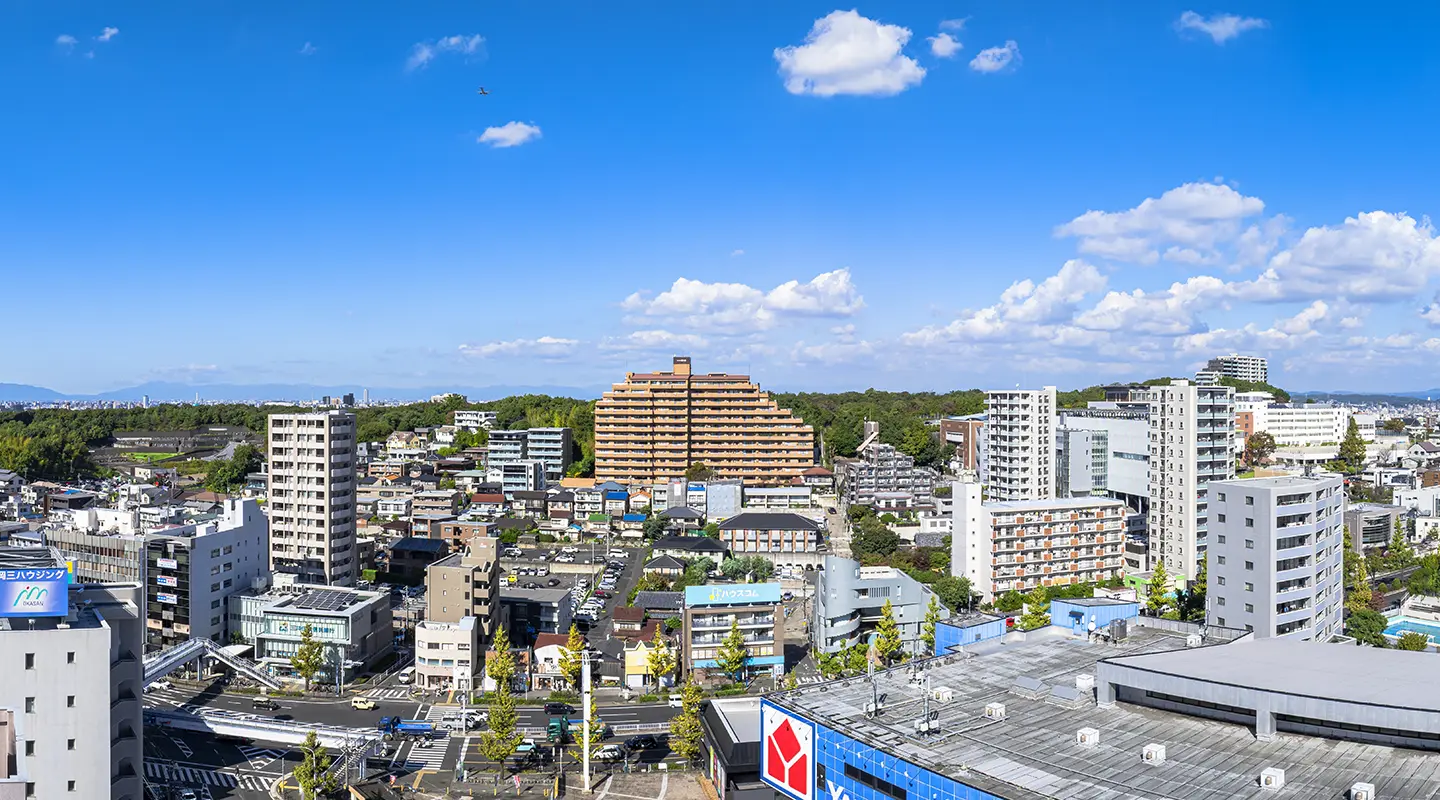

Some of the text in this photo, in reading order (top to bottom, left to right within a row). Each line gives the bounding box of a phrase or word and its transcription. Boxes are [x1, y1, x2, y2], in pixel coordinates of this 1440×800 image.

[721, 589, 760, 598] ハウスコム
